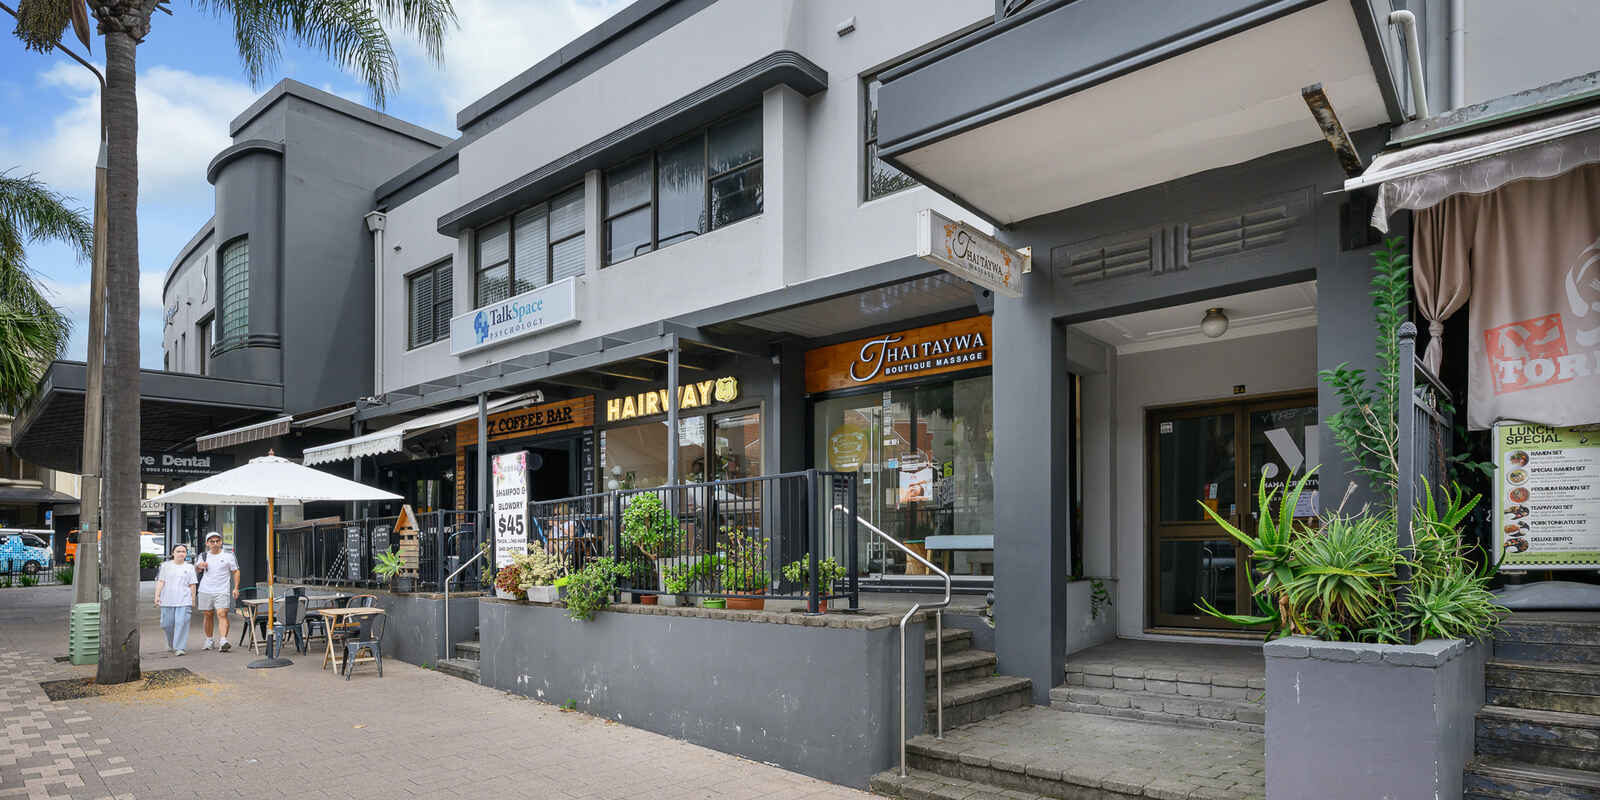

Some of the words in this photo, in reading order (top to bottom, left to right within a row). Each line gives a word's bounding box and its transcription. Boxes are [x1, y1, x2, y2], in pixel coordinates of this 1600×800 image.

[490, 299, 543, 326] TalkSpace
[490, 318, 543, 340] PSYCHOLOGY
[850, 335, 918, 382] THAI
[921, 332, 985, 357] TAYWA
[885, 360, 932, 375] BOUTIQUE
[935, 352, 983, 367] MASSAGE
[607, 379, 715, 422] HAIRWAY
[498, 411, 544, 432] COFFEE
[546, 406, 573, 424] BAR
[1506, 434, 1562, 446] SPECIAL
[1509, 425, 1555, 436] LUNCH
[162, 454, 211, 467] Dental
[496, 488, 521, 498] SHAMPOO
[498, 502, 523, 511] BLOWDRY
[498, 514, 524, 538] $45
